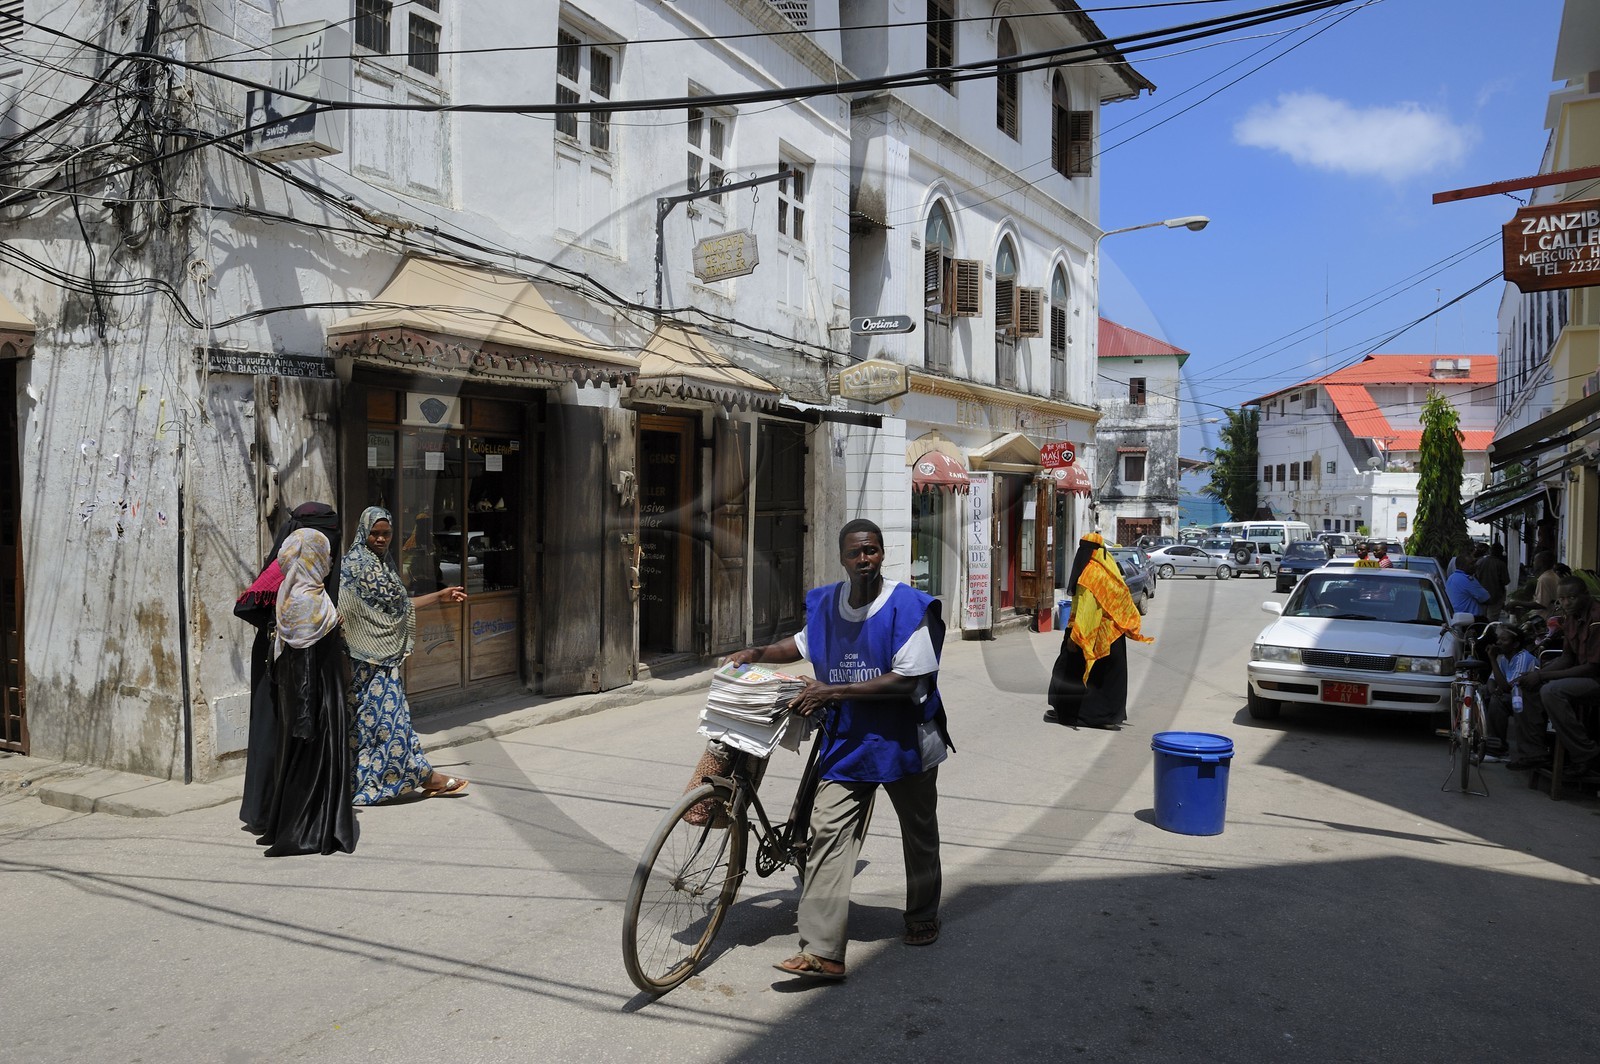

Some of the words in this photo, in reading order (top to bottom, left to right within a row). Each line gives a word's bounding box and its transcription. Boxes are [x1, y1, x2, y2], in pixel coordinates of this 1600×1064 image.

[266, 124, 289, 137] swiss
[1520, 209, 1600, 235] ZANZIB
[703, 234, 745, 253] MUSTAFA
[1538, 228, 1600, 250] GALLE
[705, 250, 732, 265] GEMS
[1519, 247, 1584, 266] MERCURY
[1532, 260, 1562, 276] TEL
[861, 318, 900, 331] Optima
[211, 355, 243, 365] RUHUSA
[297, 360, 326, 371] YOYOTE
[844, 365, 900, 391] ROAMER
[956, 400, 983, 426] EAST
[640, 502, 665, 514] usive
[973, 486, 982, 545] FOREX
[640, 516, 663, 528] eller
[971, 552, 986, 563] DE
[1357, 561, 1377, 569] TAXI
[1341, 684, 1359, 693] 226
